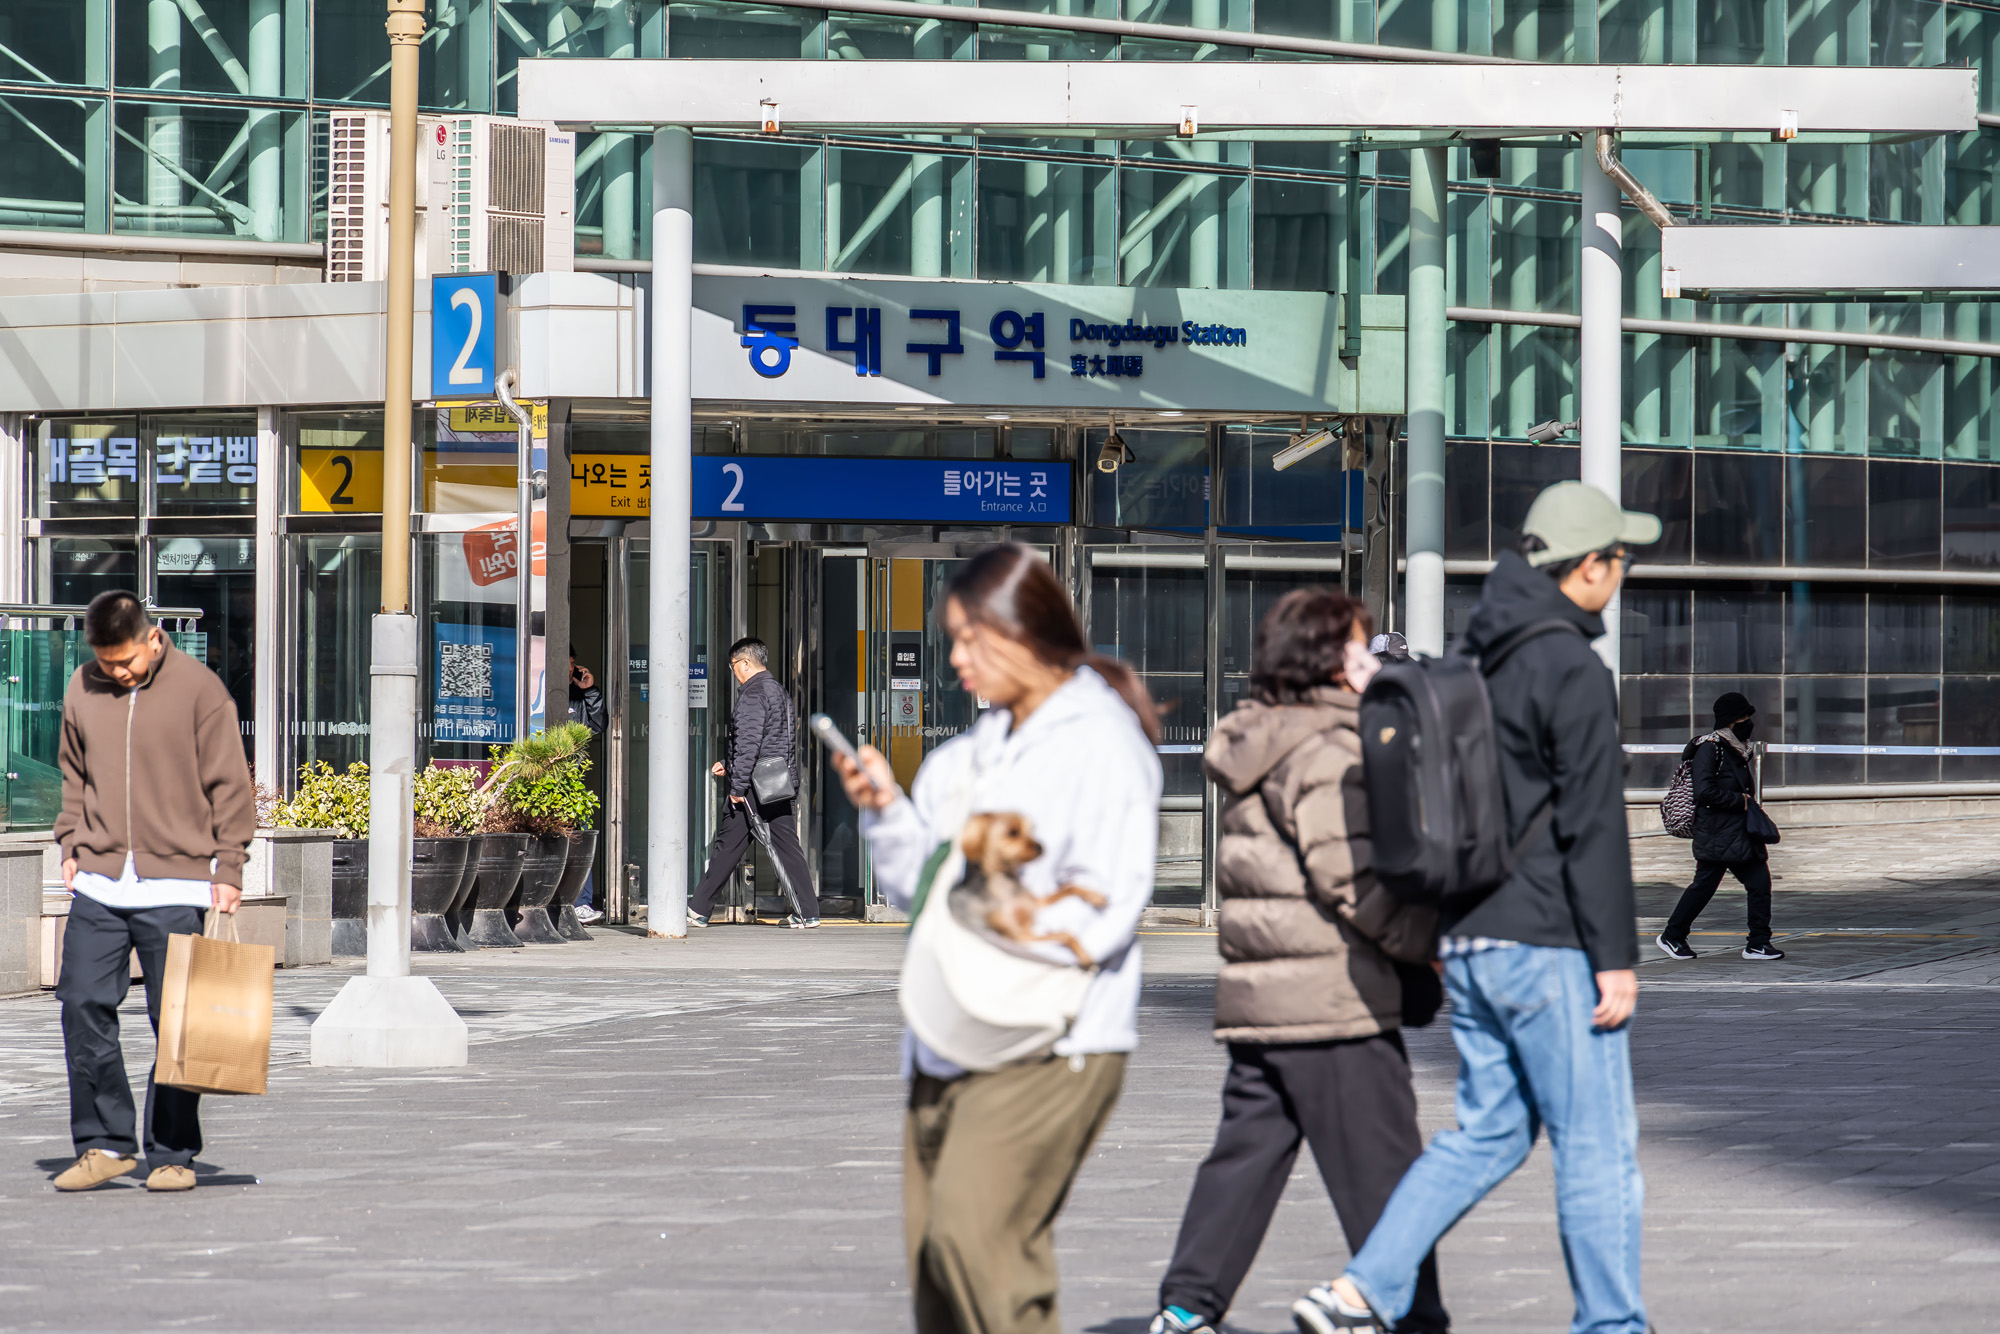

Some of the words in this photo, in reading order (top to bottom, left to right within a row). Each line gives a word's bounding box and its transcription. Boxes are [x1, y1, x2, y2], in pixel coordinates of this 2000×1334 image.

[549, 136, 570, 145] SAMSUNG
[436, 149, 446, 160] LG
[448, 287, 483, 385] 2
[740, 304, 1046, 379] 동대구역
[1069, 318, 1179, 347] Dongdaegu
[1181, 320, 1247, 347] Station
[330, 455, 354, 505] 2
[571, 463, 627, 488] 나오는
[721, 463, 745, 512] 2
[943, 470, 1021, 497] 들어가는
[1029, 471, 1048, 498] 곳
[611, 496, 631, 508] Exit
[981, 501, 1023, 512] Entrance
[1028, 502, 1047, 512] 入口
[897, 652, 916, 662] 출입문
